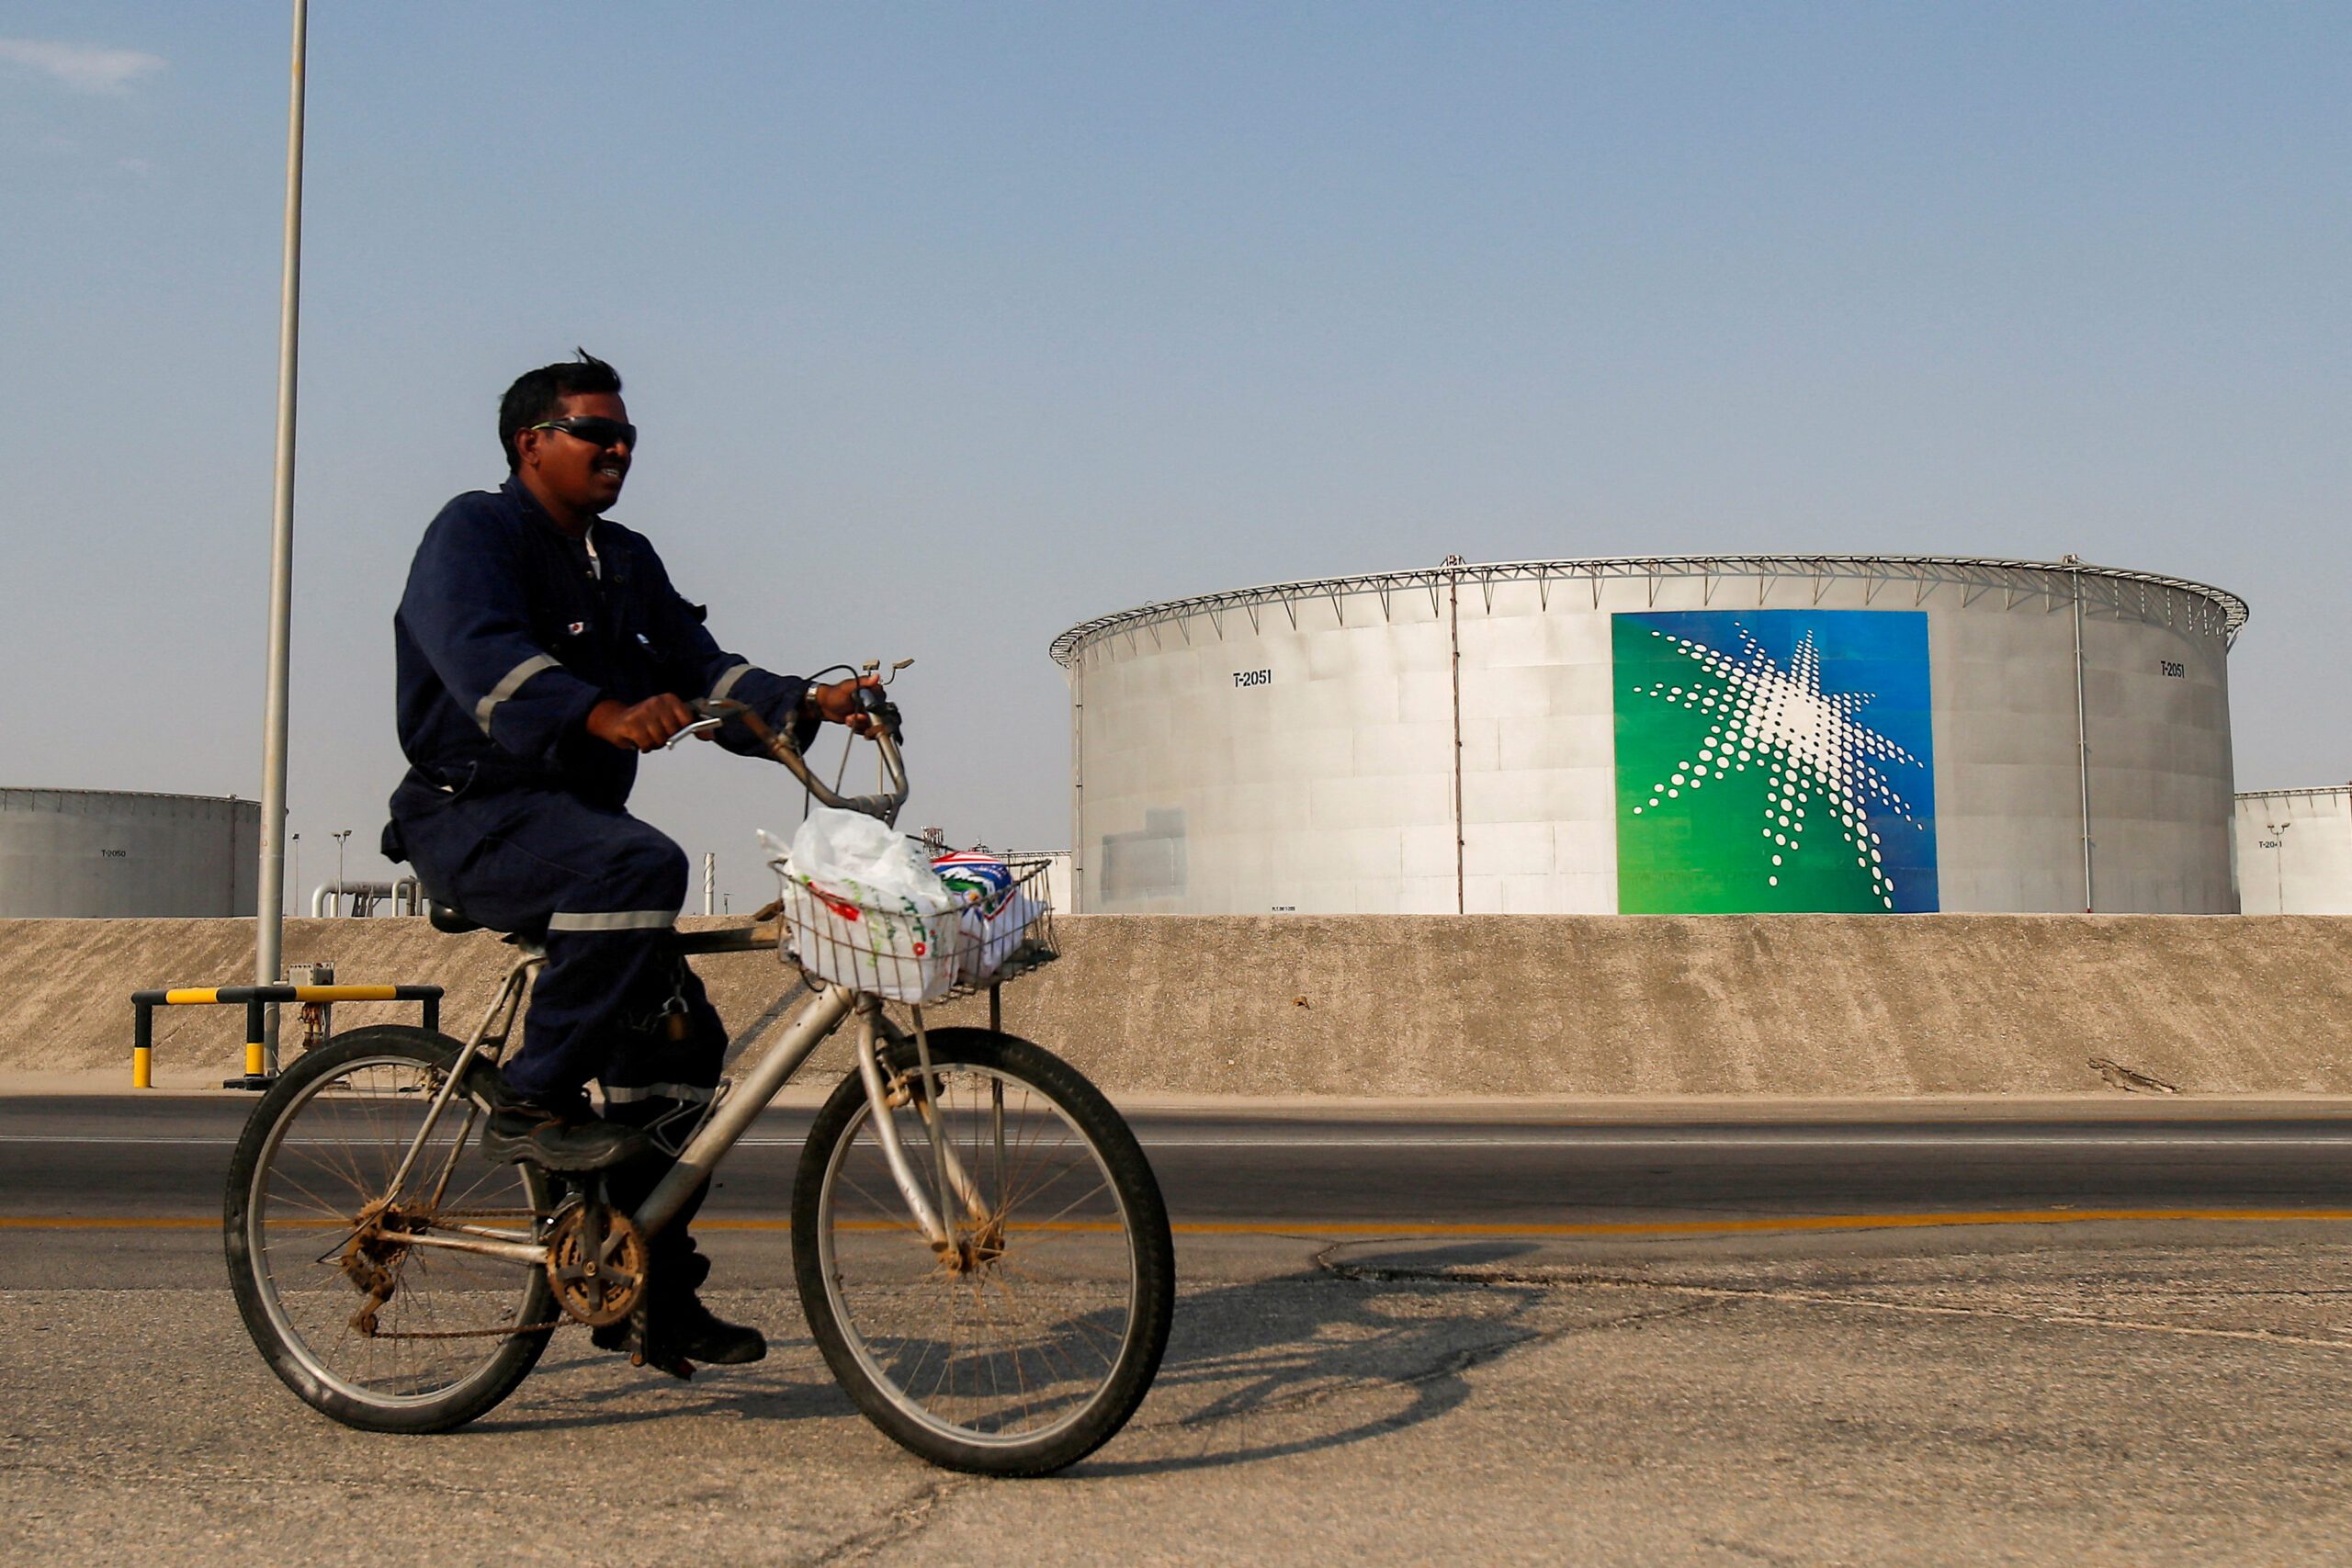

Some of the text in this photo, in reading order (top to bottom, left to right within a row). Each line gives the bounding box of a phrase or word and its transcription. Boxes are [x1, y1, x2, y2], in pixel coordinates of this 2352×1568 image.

[1233, 669, 1272, 688] T-2051
[2161, 660, 2185, 679] T-2051
[101, 849, 126, 857] T-2050
